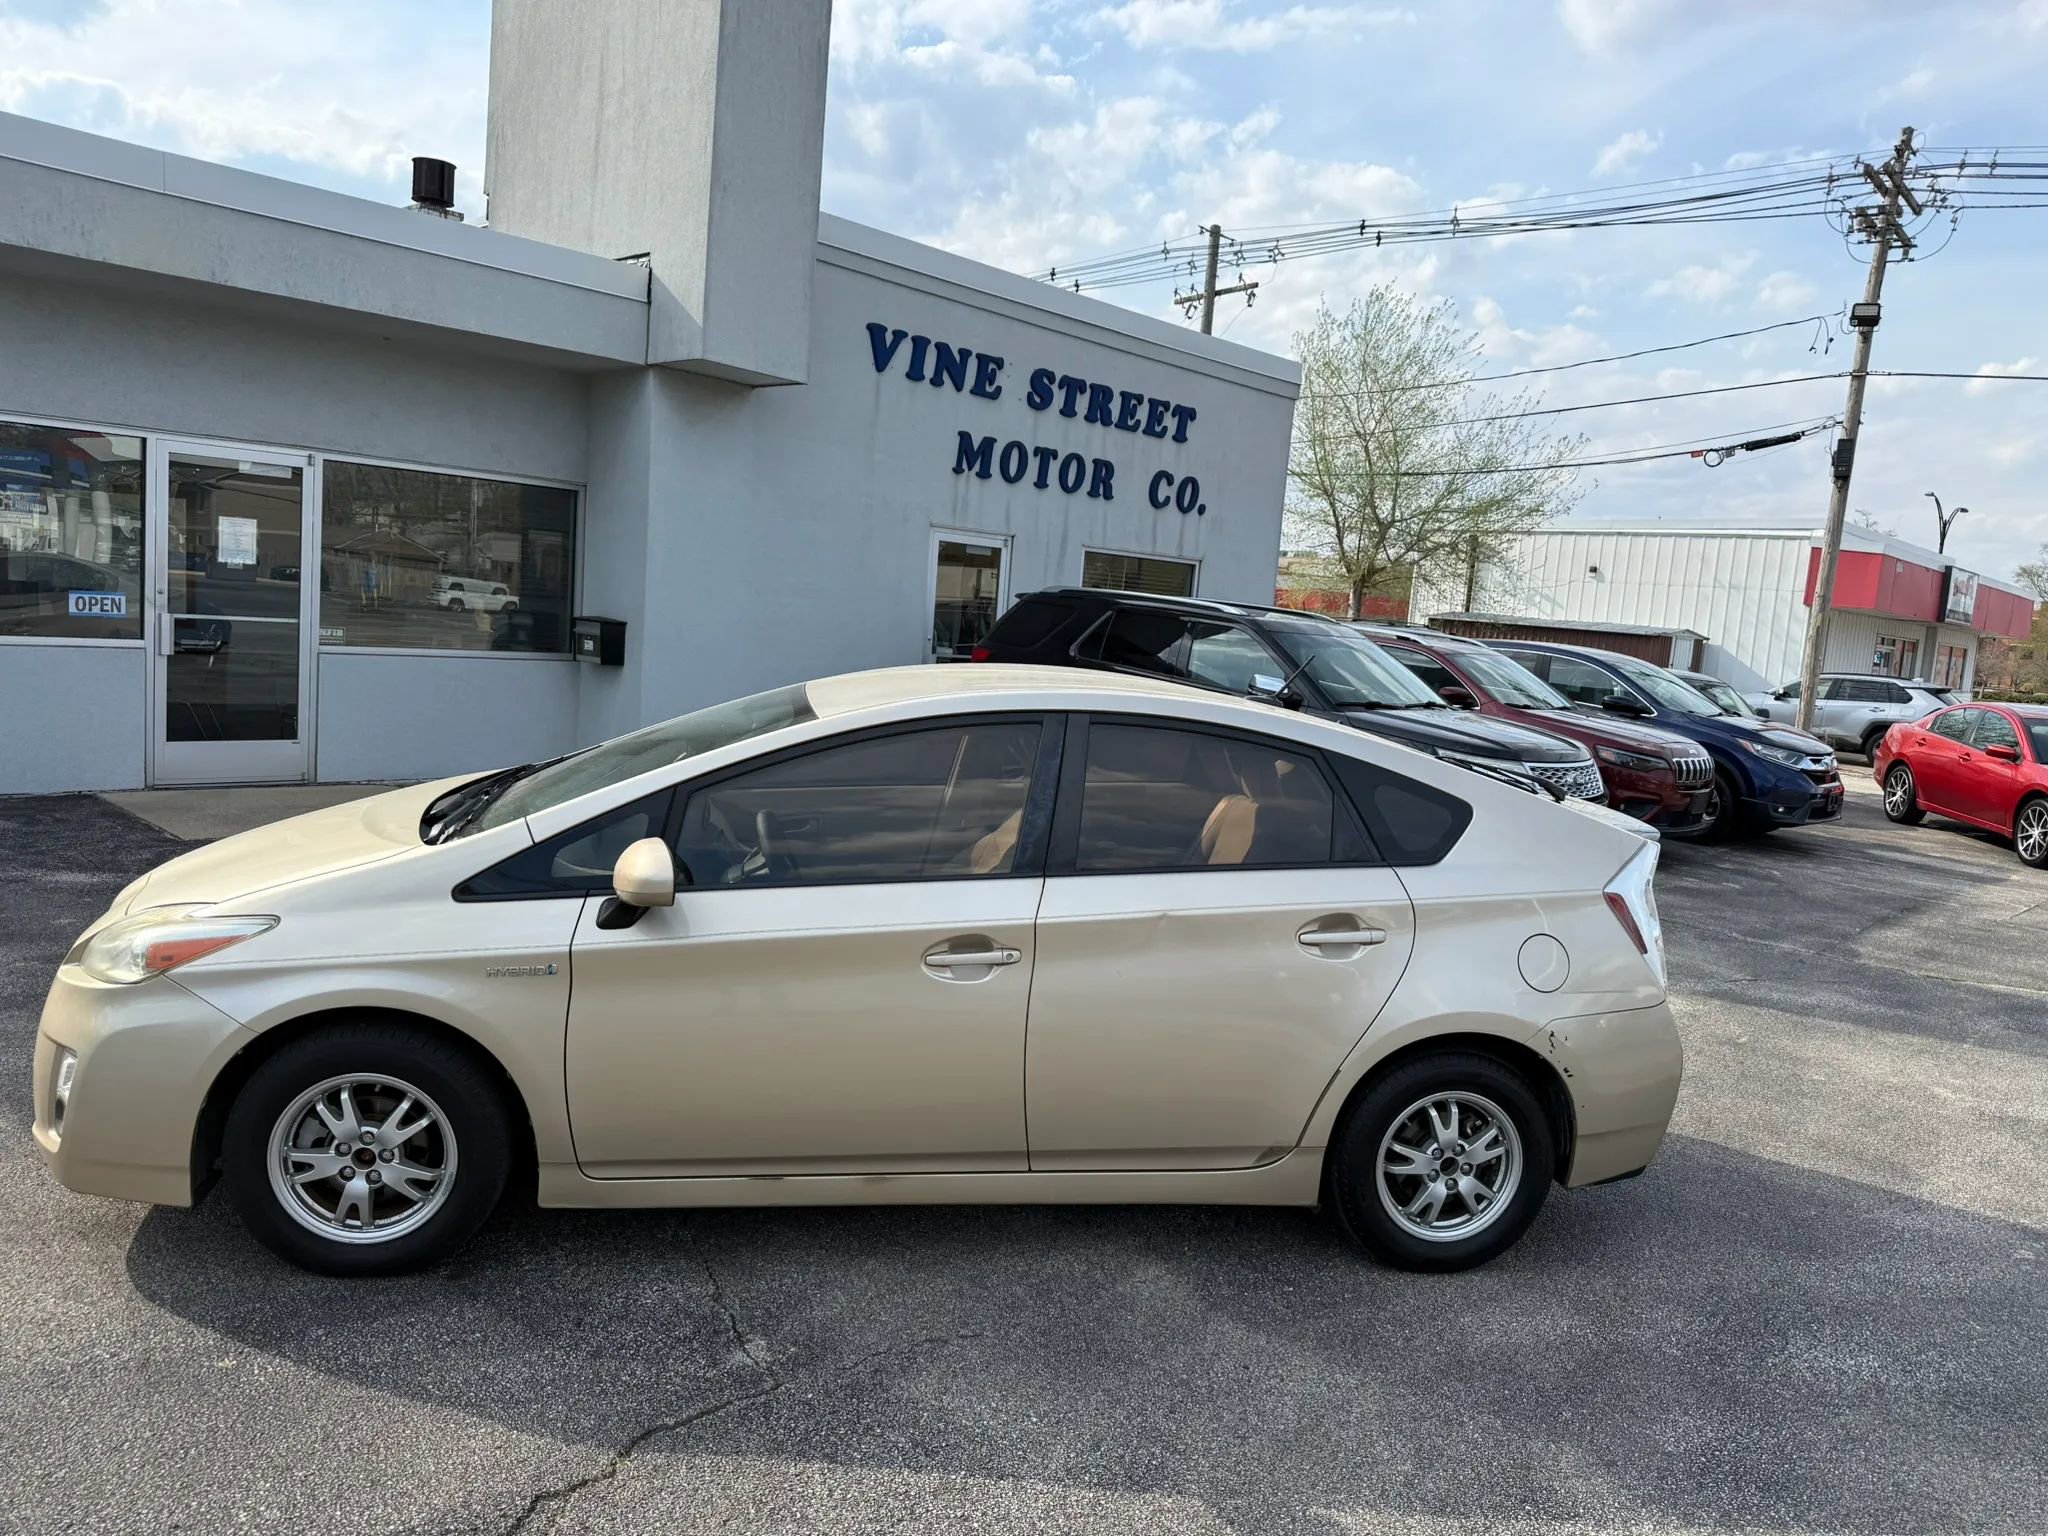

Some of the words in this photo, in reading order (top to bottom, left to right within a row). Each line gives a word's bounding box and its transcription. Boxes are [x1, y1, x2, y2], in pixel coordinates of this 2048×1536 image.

[866, 322, 1005, 401] VINE
[1026, 367, 1197, 444] STREET
[951, 430, 1116, 501] MOTOR
[1148, 469, 1207, 517] CO.
[74, 595, 122, 613] OPEN
[486, 965, 547, 978] HYBRID
